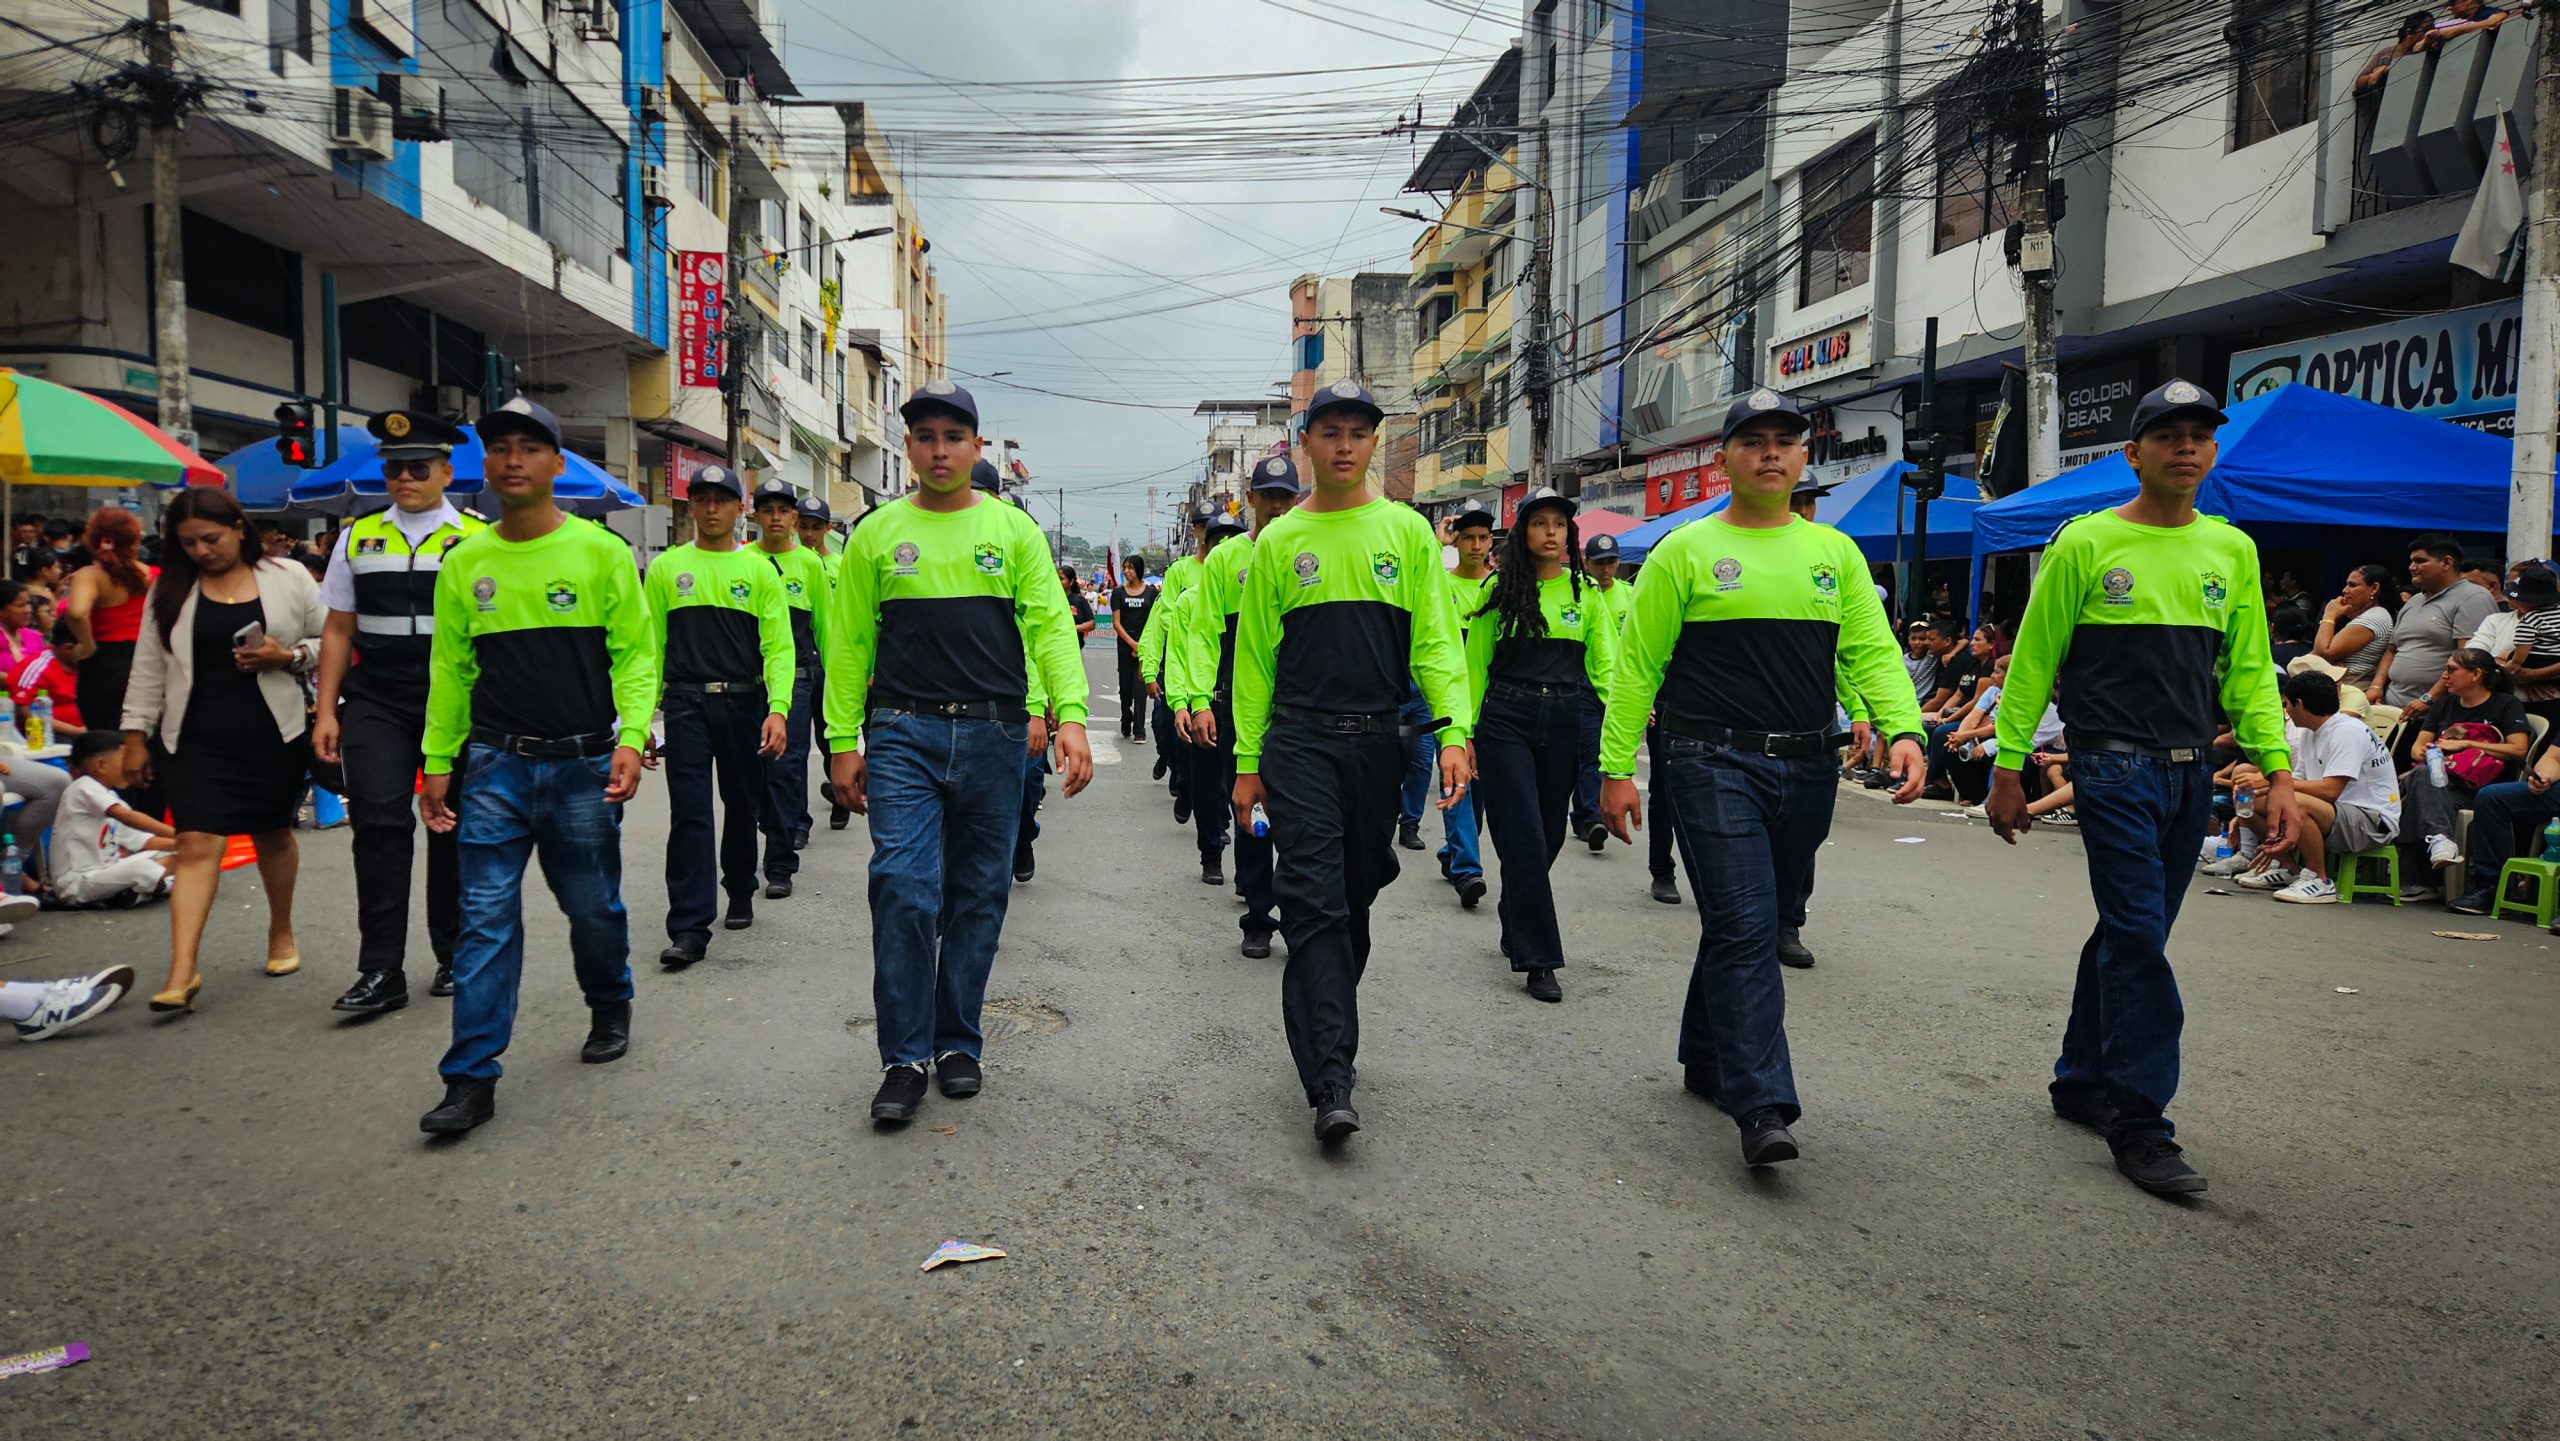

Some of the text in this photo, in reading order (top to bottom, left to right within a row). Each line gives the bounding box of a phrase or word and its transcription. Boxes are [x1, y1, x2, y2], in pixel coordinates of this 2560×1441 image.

[2031, 241, 2044, 251] N11
[681, 253, 699, 385] farmacias
[704, 289, 719, 377] suiza
[1780, 331, 1850, 375] COOL KIDS
[2305, 329, 2457, 411] OPTICA
[1980, 400, 2002, 413] TITA
[2068, 379, 2132, 408] GOLDEN
[2067, 405, 2112, 428] BEAR
[1830, 463, 1871, 479] TOP MODA
[2065, 453, 2090, 467] MOTO
